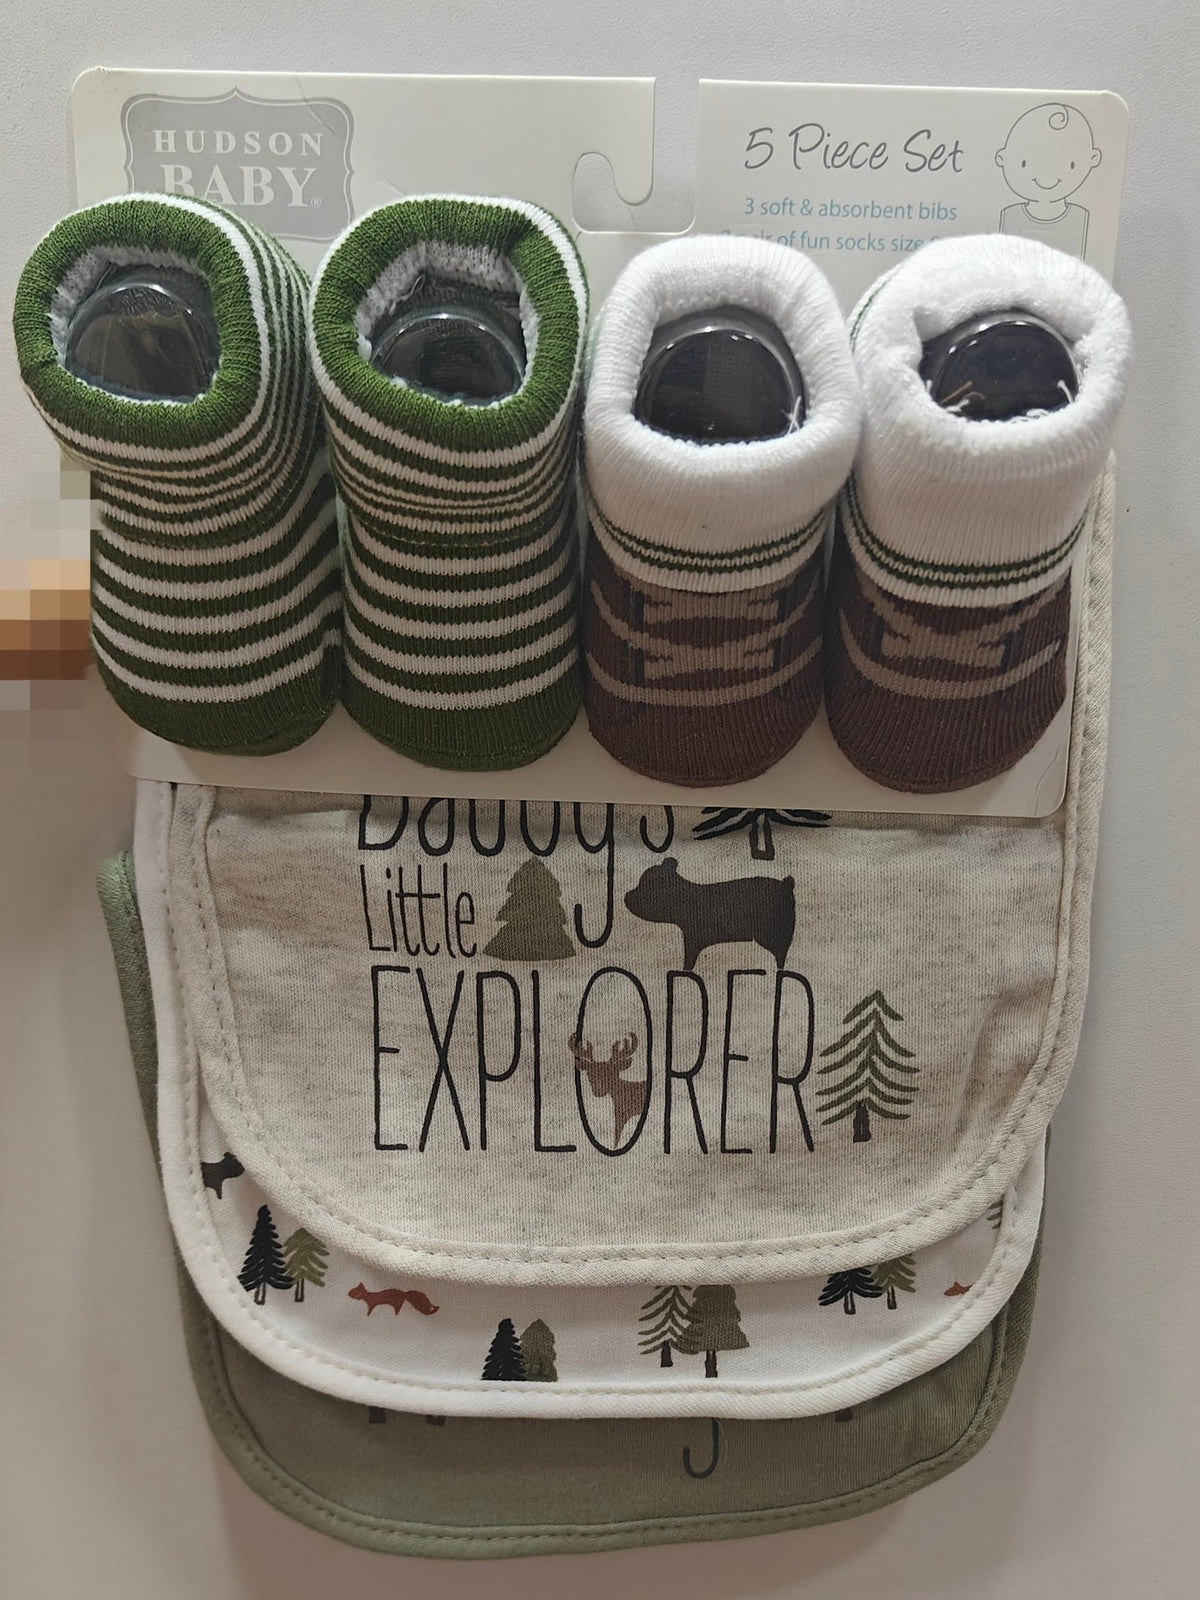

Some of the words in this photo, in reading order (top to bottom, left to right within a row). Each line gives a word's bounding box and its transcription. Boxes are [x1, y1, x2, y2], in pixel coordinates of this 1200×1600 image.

[152, 129, 323, 157] HUDSON
[743, 126, 774, 170] 5
[787, 122, 889, 171] Piece
[902, 128, 964, 173] Set
[744, 197, 755, 216] 3
[760, 197, 796, 217] soft
[800, 198, 814, 217] &
[818, 198, 914, 219] absorbent
[918, 201, 958, 221] bibs
[800, 230, 830, 250] fun
[835, 232, 886, 252] socks
[890, 236, 925, 252] size
[359, 862, 478, 959] Little
[371, 965, 816, 1157] EXPLORER
